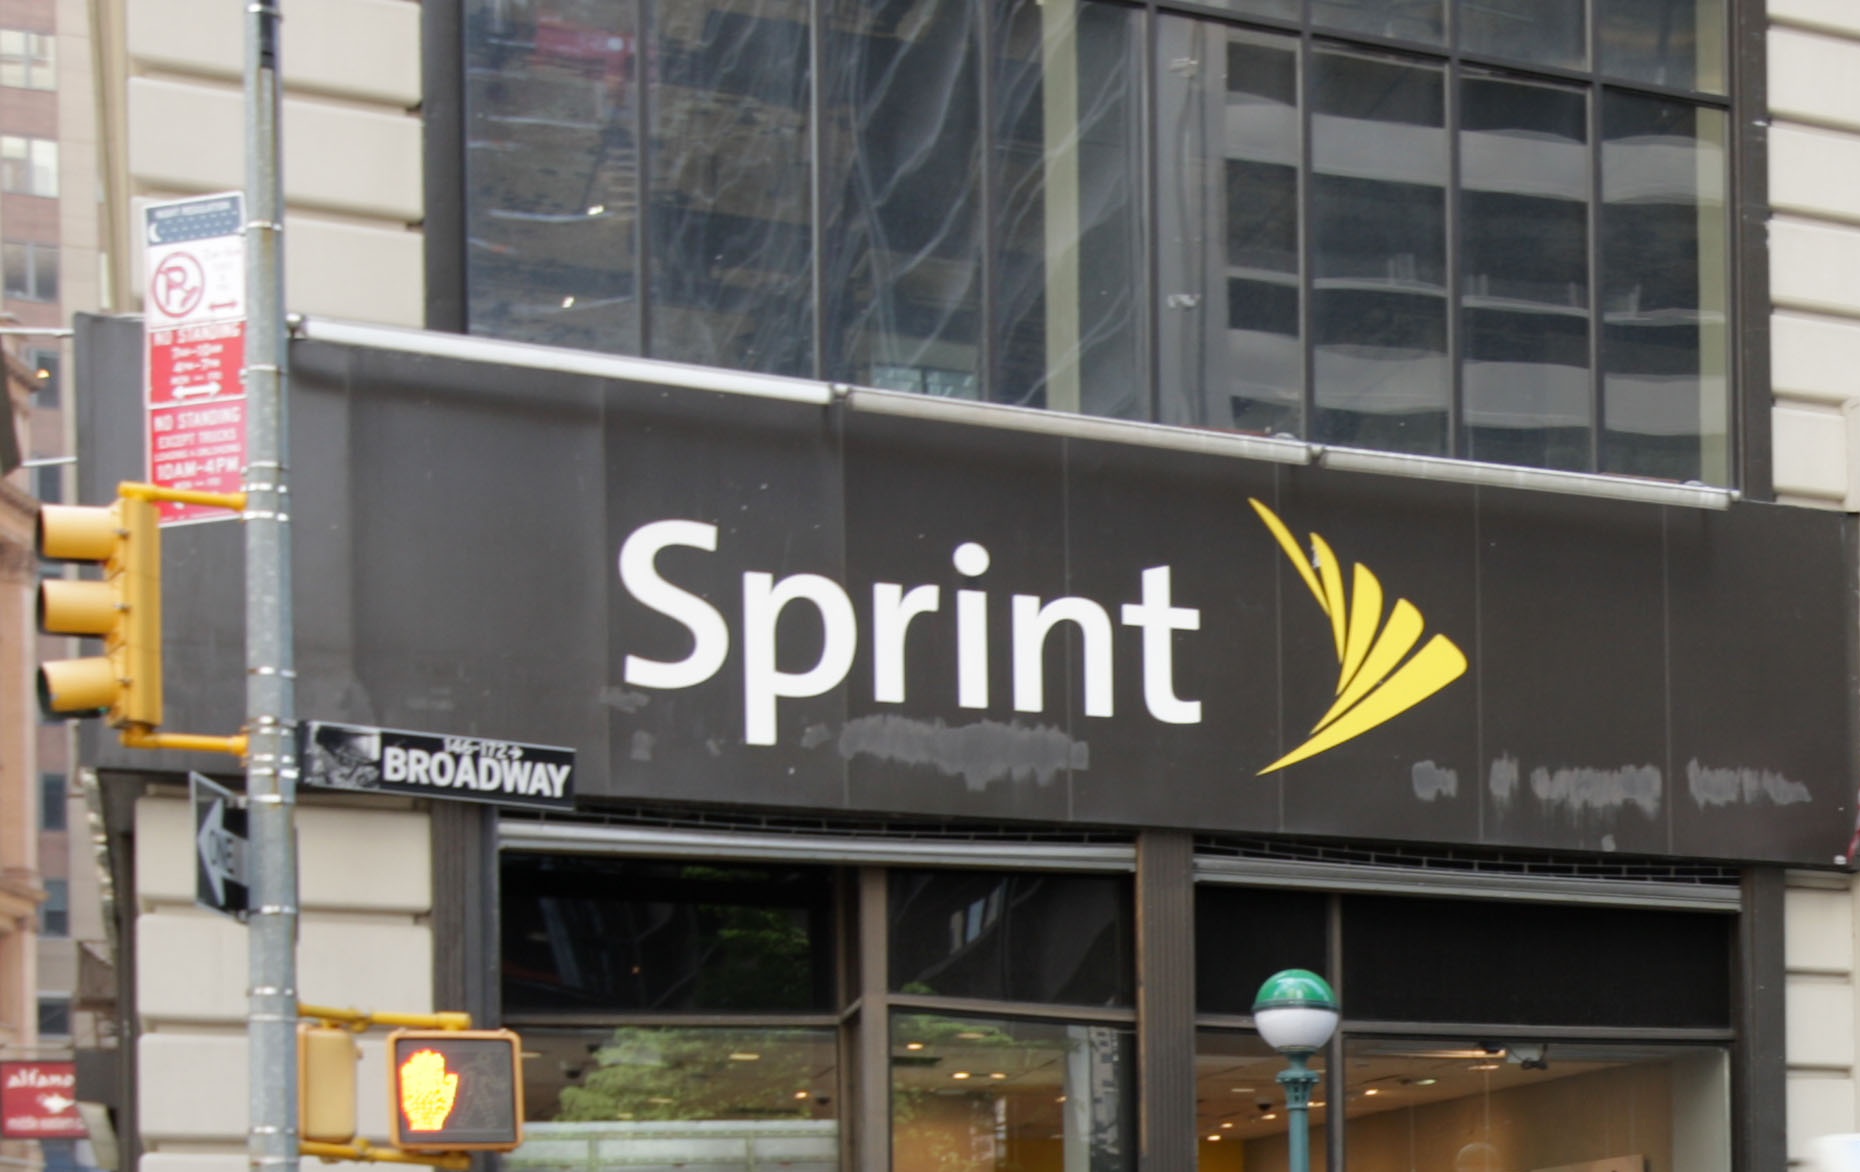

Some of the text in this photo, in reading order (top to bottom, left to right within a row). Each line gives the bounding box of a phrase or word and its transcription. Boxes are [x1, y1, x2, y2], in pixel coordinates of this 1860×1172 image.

[153, 406, 241, 431] NO STANDING
[619, 519, 1202, 745] Sprint
[383, 746, 571, 798] BROADWAY
